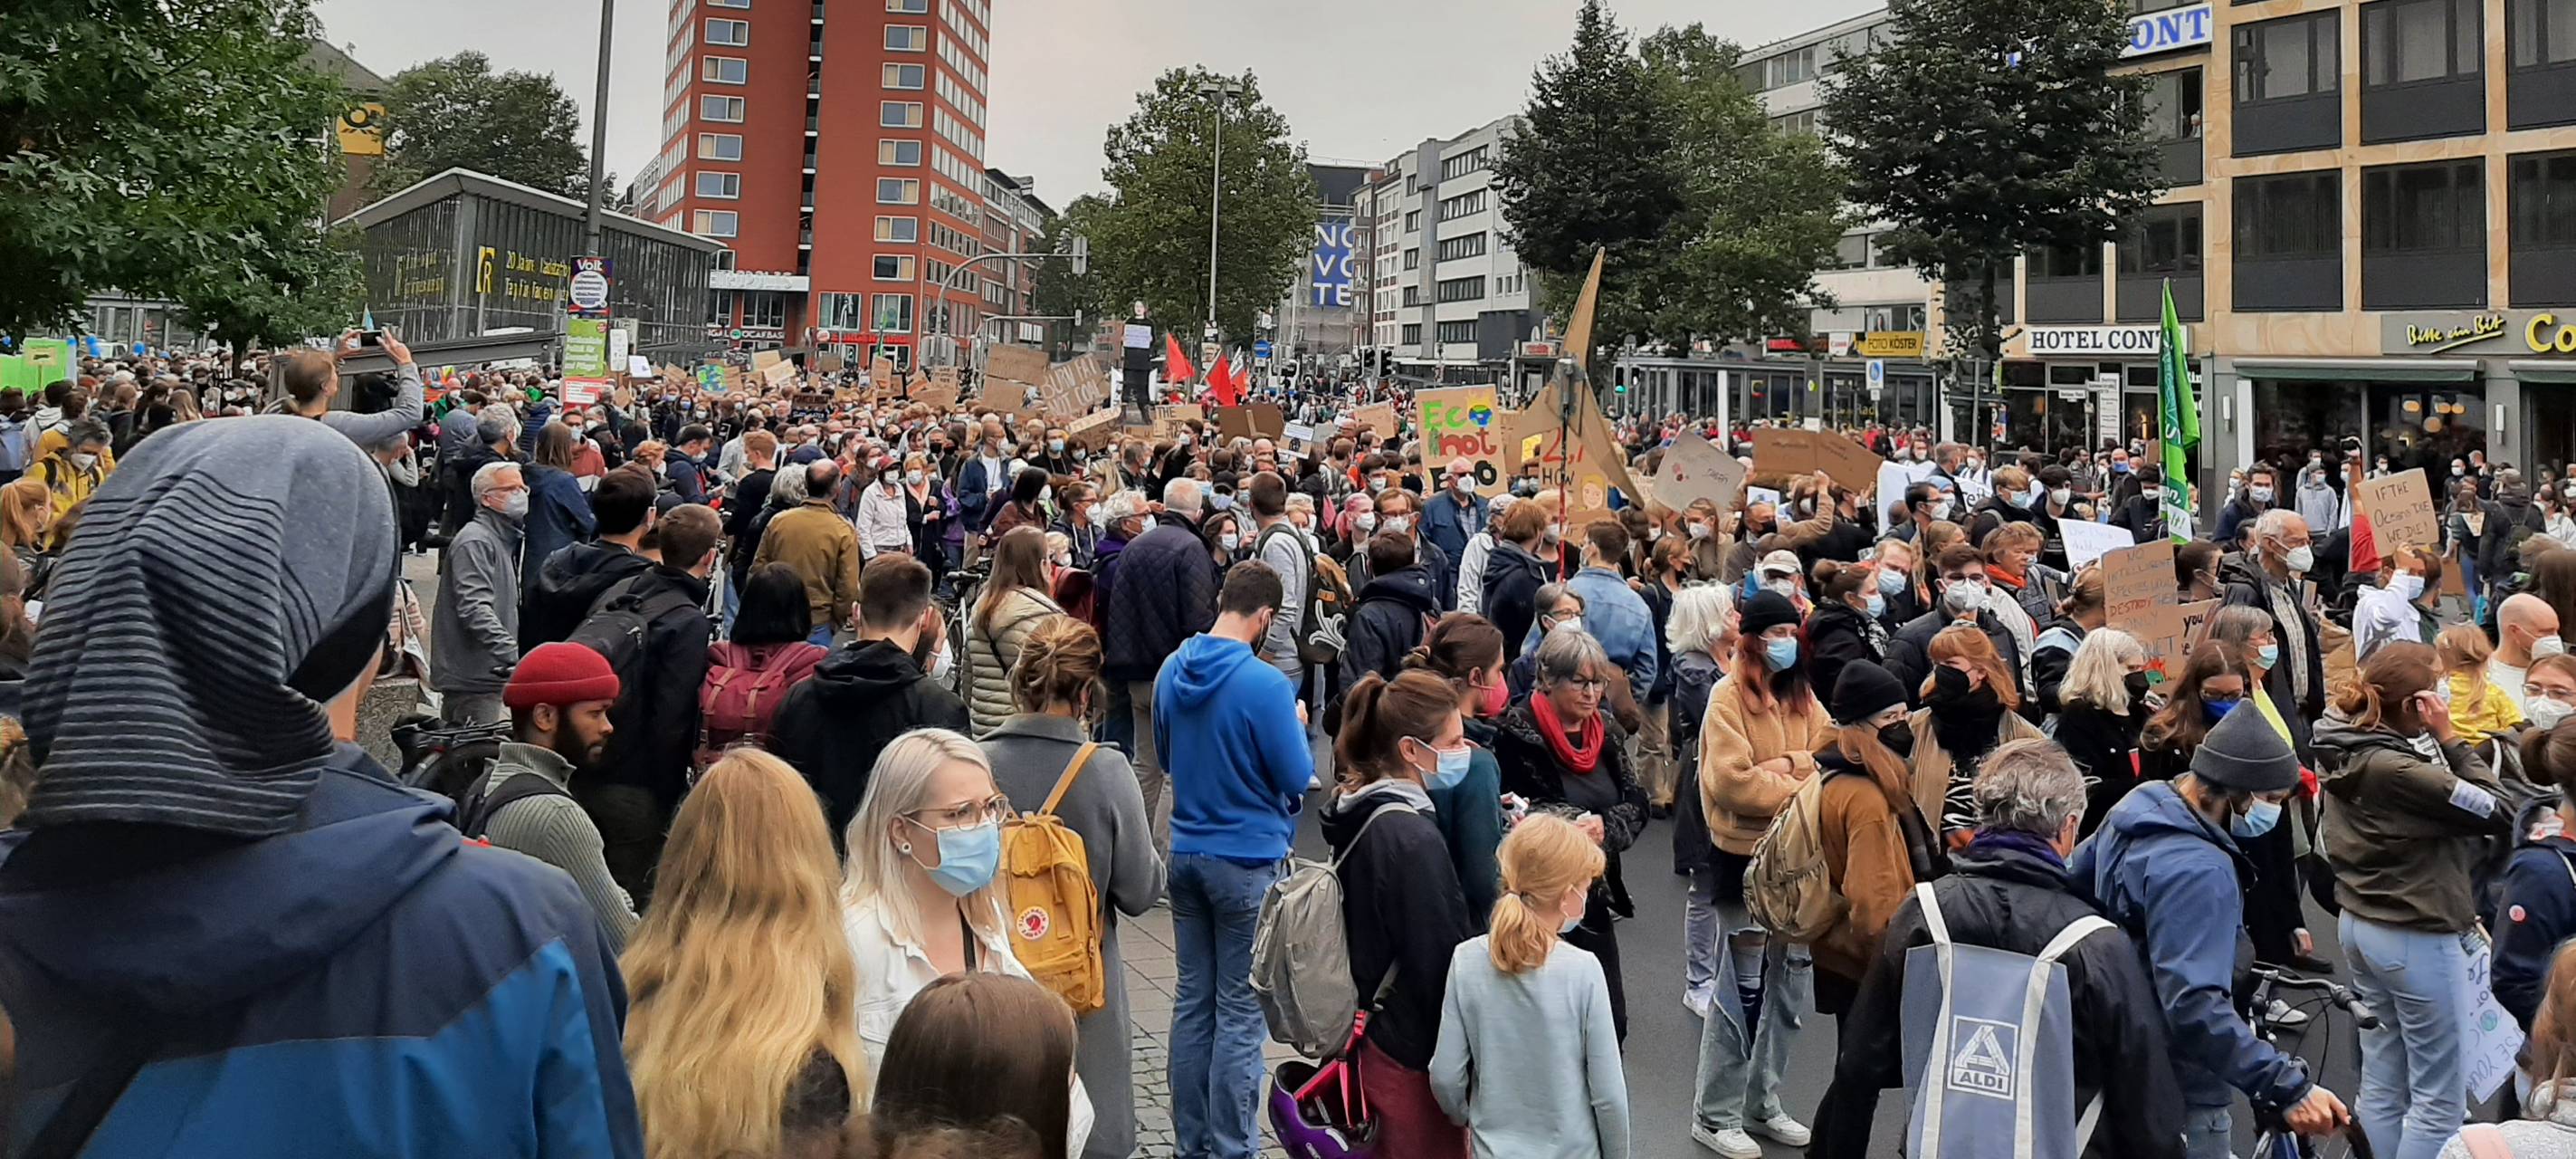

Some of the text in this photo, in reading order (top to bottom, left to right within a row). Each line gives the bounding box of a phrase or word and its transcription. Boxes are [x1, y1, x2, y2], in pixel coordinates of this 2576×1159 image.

[506, 250, 516, 269] 20
[577, 259, 604, 272] Volt
[2407, 314, 2505, 346] Bitte ein Bit
[1868, 335, 1917, 350] FOTO KÖSTER
[2032, 330, 2104, 350] HOTEL
[1429, 460, 1497, 493] EO
[2375, 482, 2409, 501] IF THE
[2386, 528, 2402, 543] WE
[2110, 597, 2151, 617] DESTROY
[2183, 614, 2203, 637] you
[1960, 1071, 2003, 1089] ALDI
